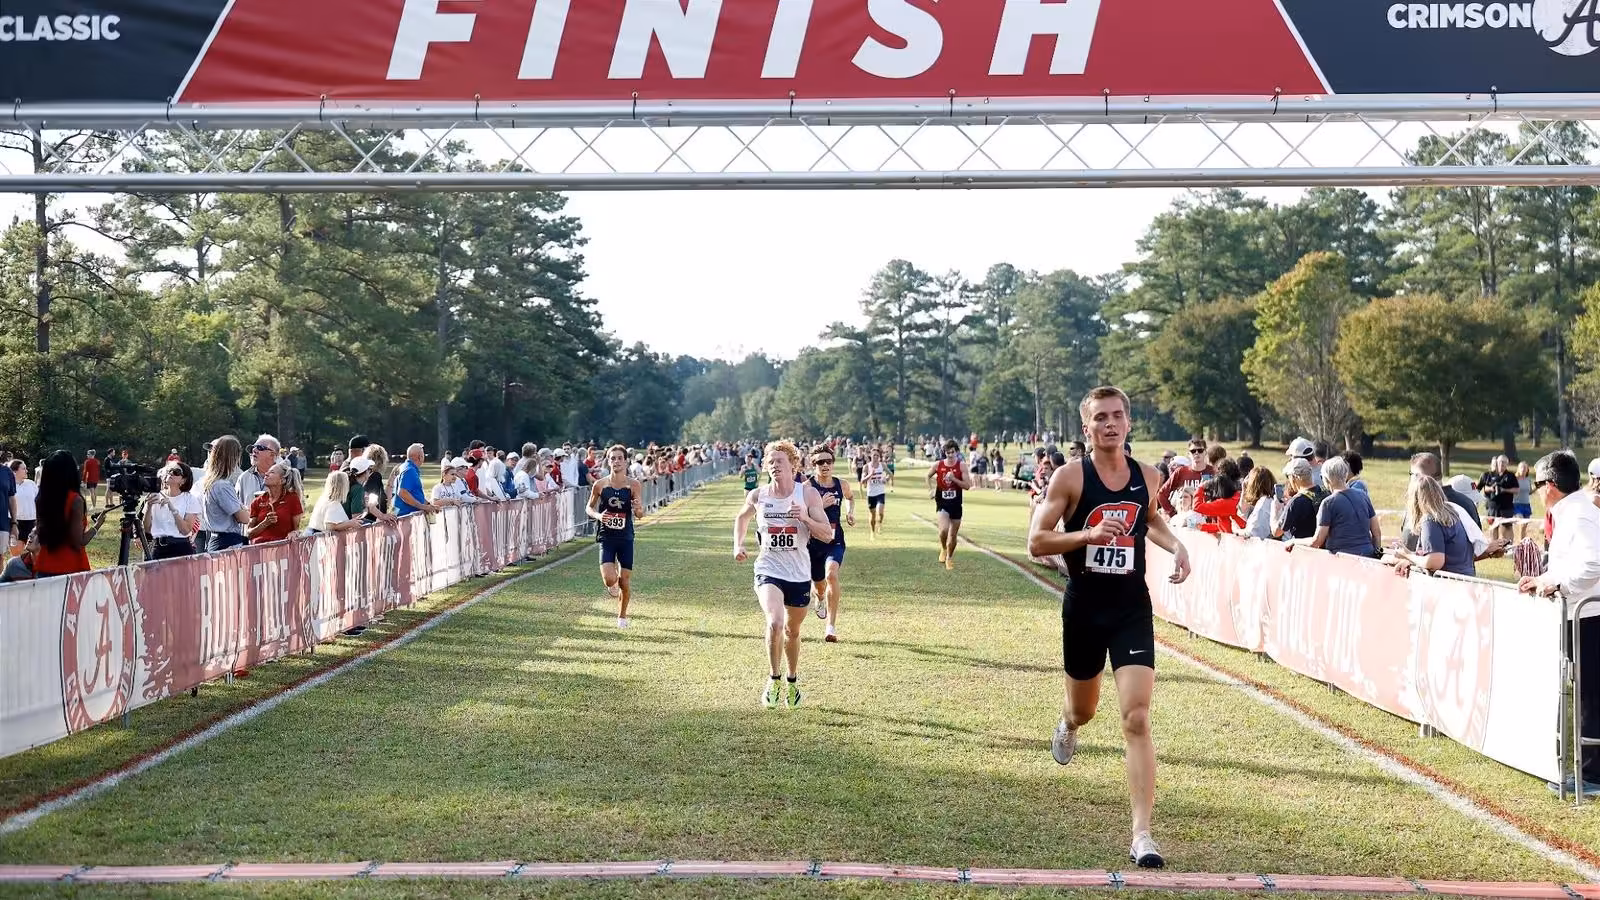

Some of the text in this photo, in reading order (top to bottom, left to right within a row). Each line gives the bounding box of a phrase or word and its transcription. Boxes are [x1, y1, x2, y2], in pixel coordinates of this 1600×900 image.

[0, 14, 121, 42] CLASSIC
[1386, 2, 1532, 29] CRIMSON
[385, 0, 1101, 80] FINISH
[770, 534, 794, 548] 386
[1093, 547, 1127, 569] 475
[200, 567, 246, 664] ROLL
[253, 557, 290, 647] TIDE
